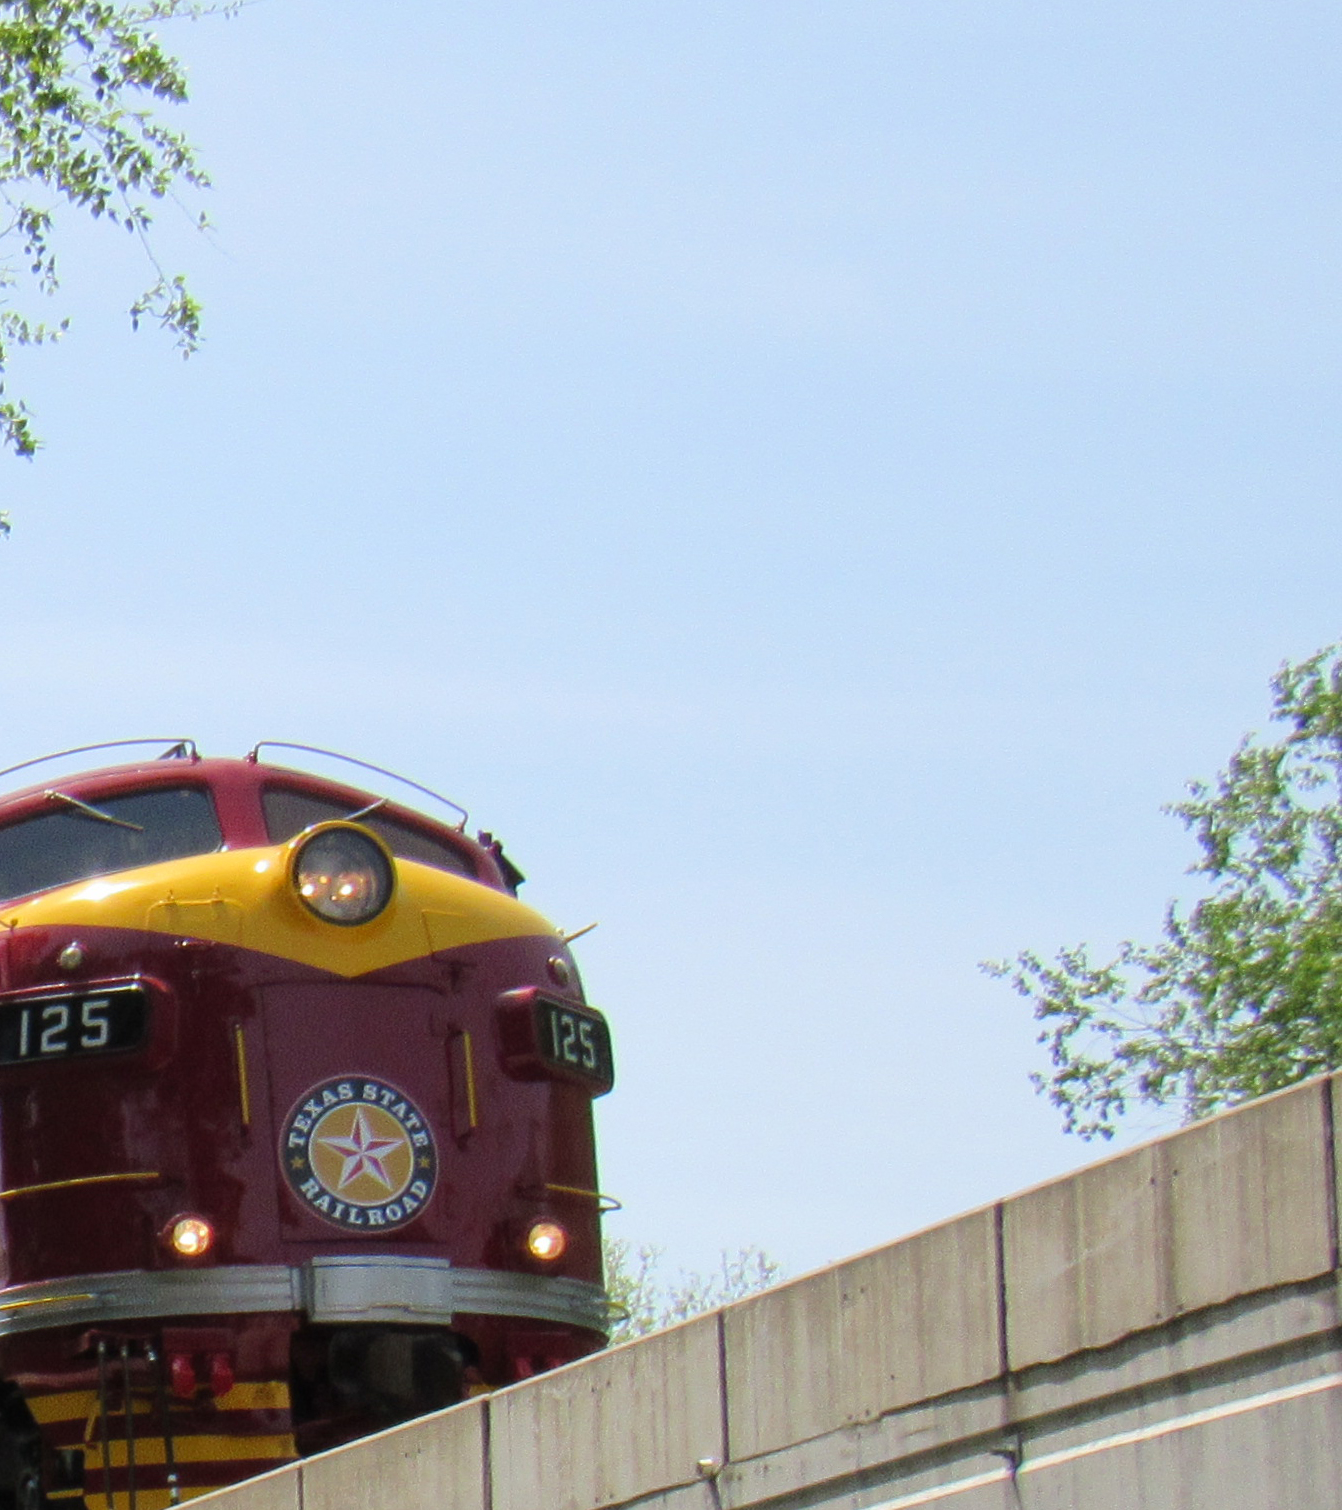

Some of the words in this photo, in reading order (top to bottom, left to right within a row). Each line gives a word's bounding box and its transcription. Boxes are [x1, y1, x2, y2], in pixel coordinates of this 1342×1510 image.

[20, 1000, 109, 1056] 125
[551, 1011, 595, 1069] 125
[288, 1083, 353, 1148] TEXAS
[362, 1084, 429, 1147] STATE
[300, 1180, 426, 1225] RAILROAD
